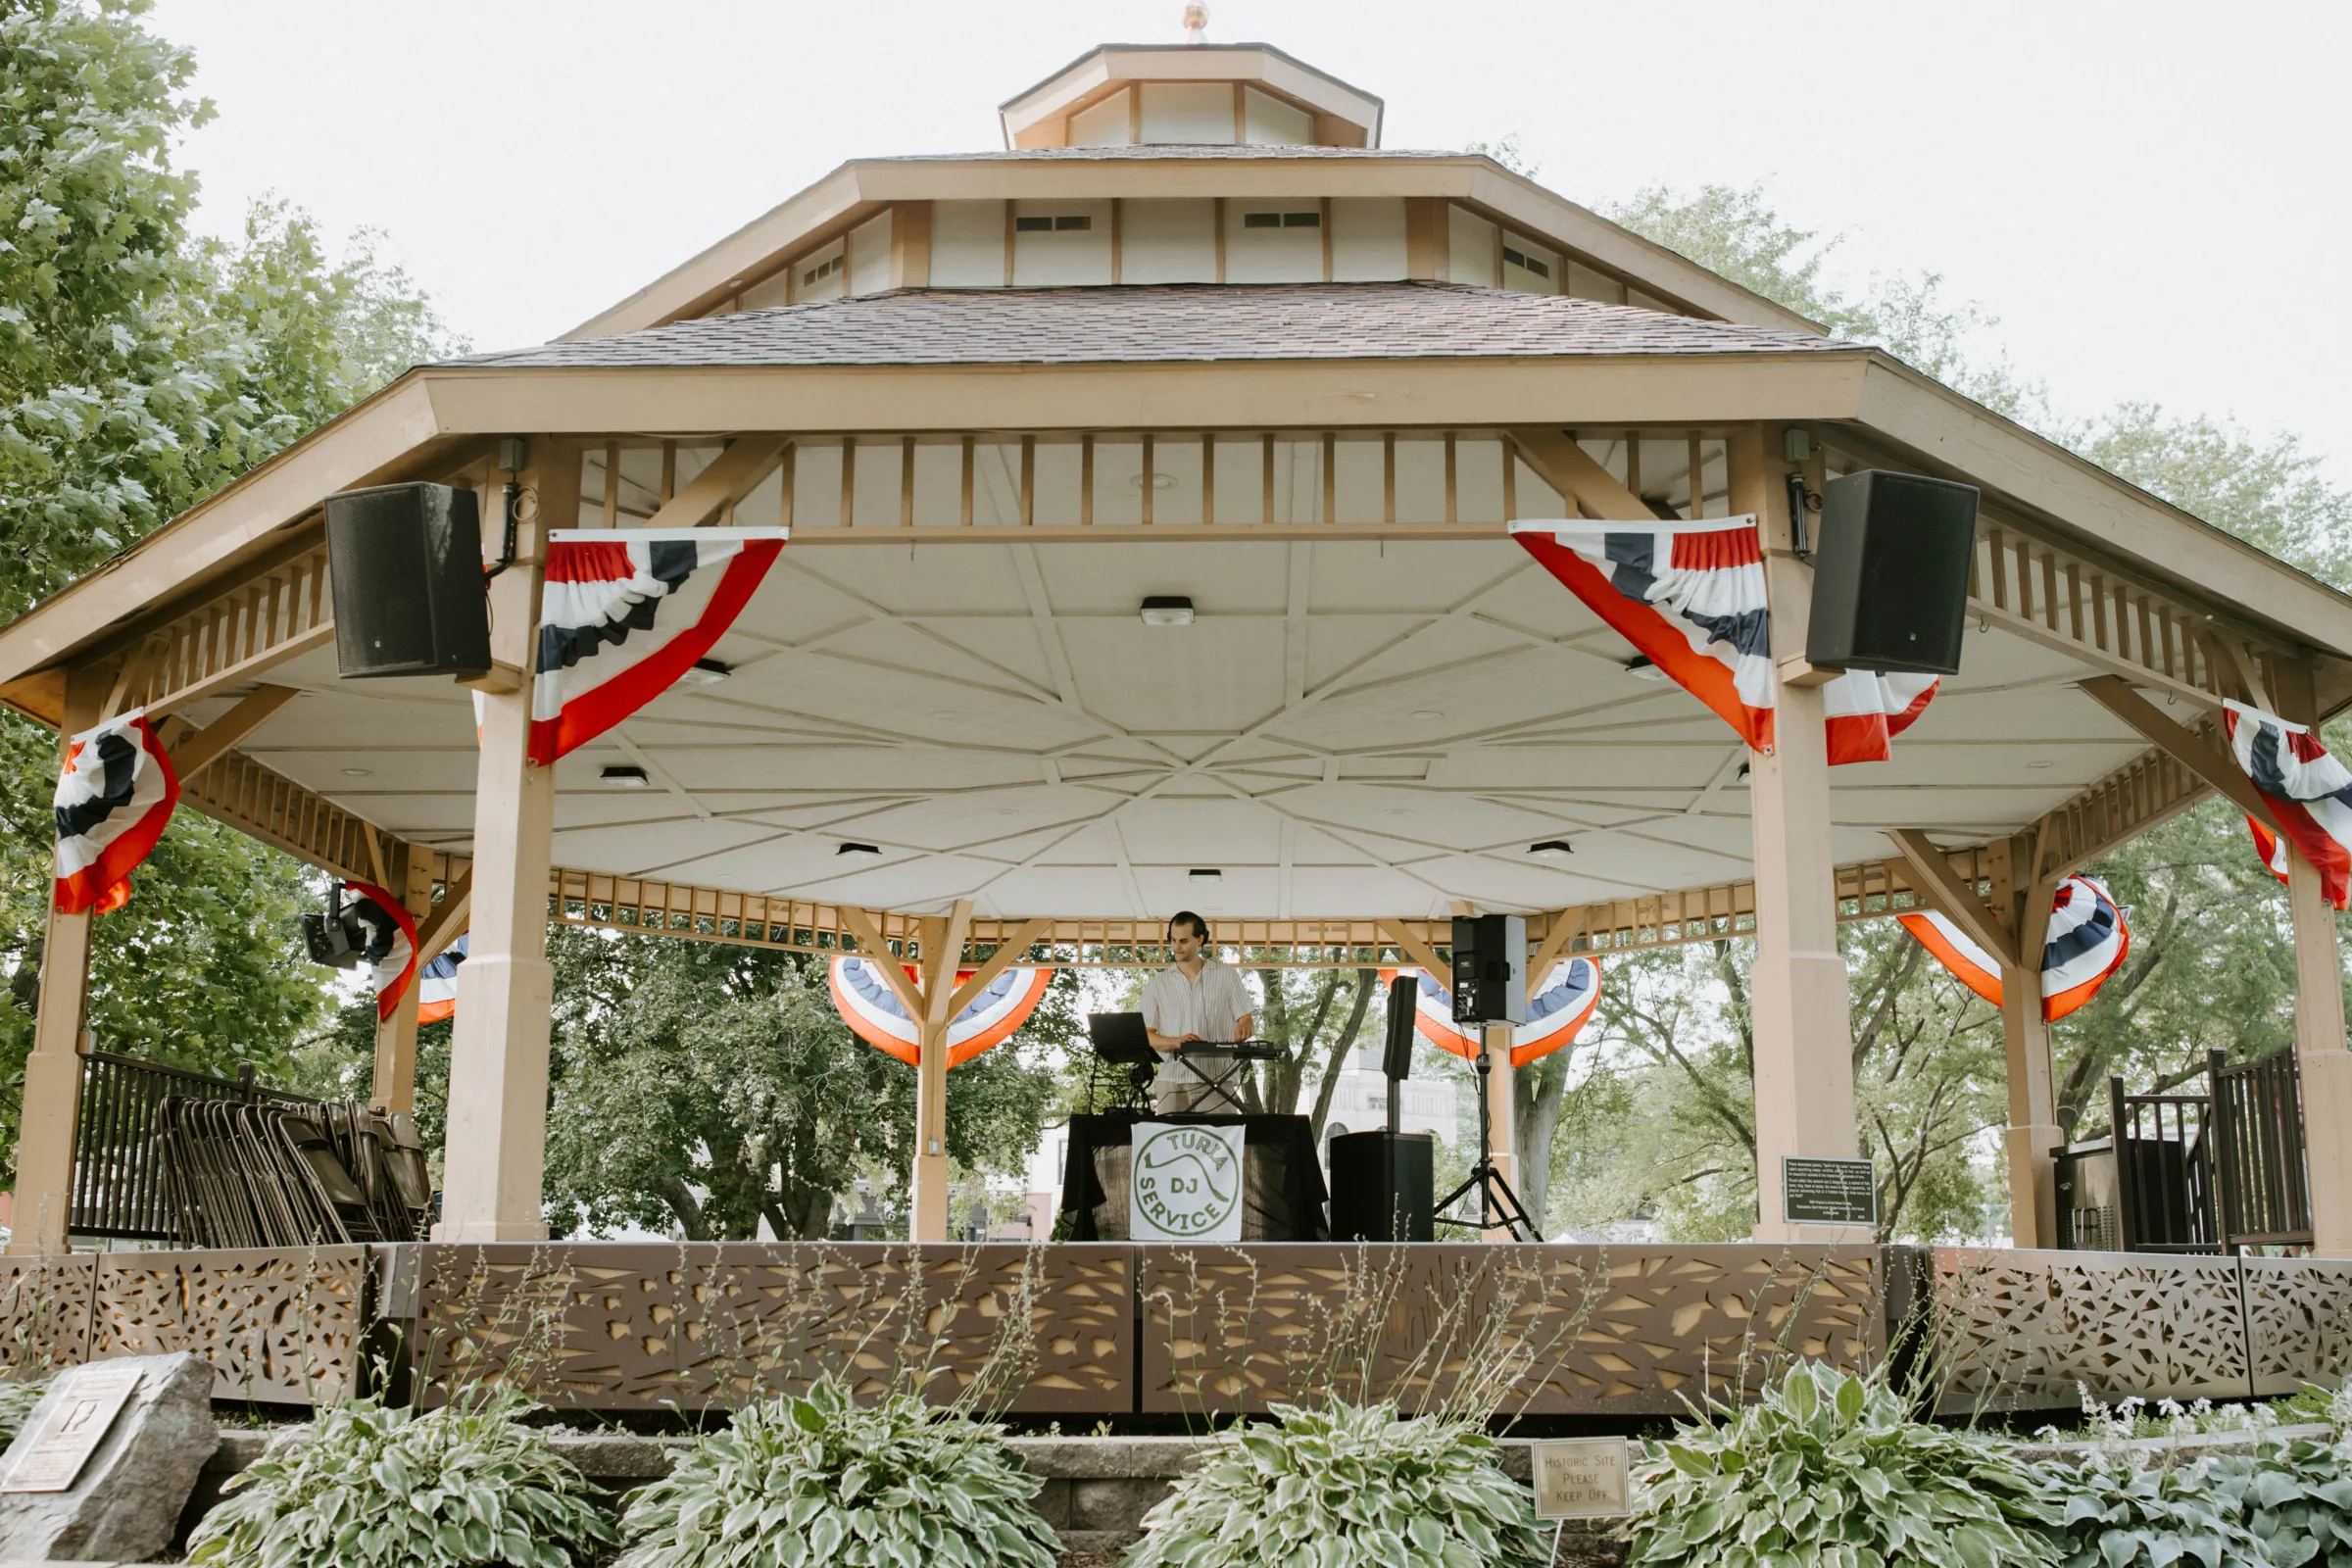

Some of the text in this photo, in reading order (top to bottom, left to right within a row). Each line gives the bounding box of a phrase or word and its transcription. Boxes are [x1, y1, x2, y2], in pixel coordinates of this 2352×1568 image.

[1167, 1133, 1228, 1172] TURIA
[1171, 1178, 1198, 1194] DJ
[1140, 1177, 1220, 1230] SERVICE
[1545, 1456, 1588, 1468] HISTORIC
[1564, 1473, 1599, 1484] PLEASE
[1556, 1490, 1609, 1501] KEEP OFF
